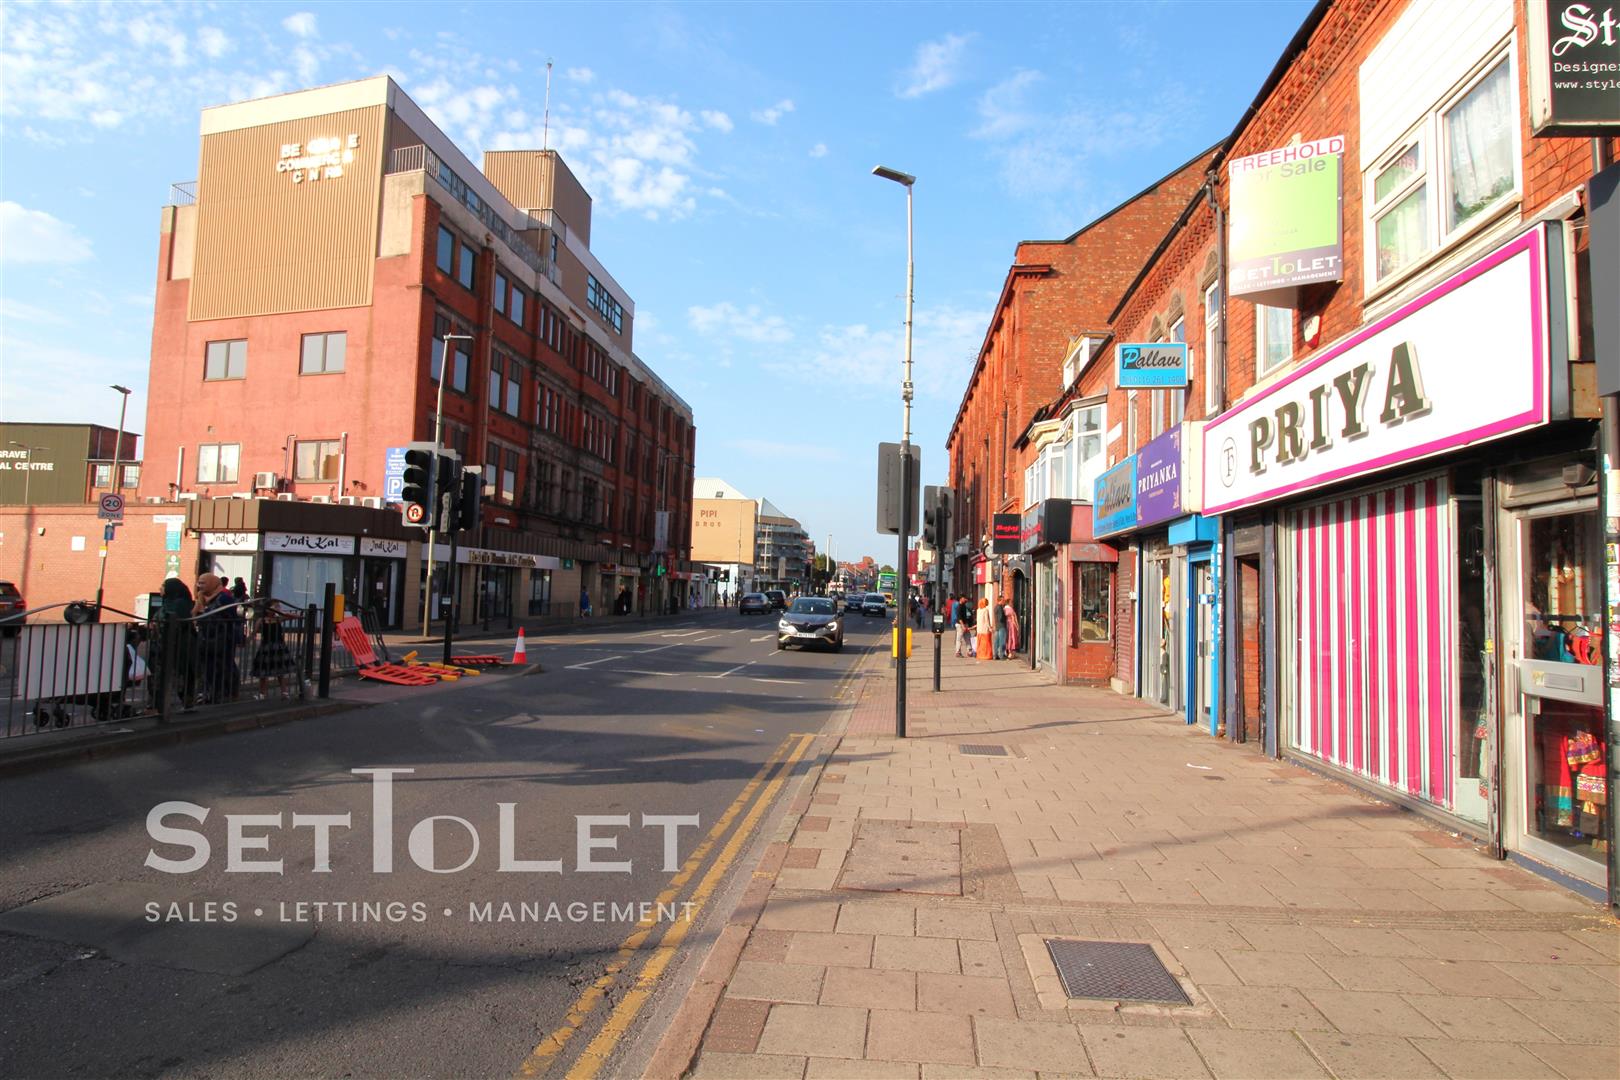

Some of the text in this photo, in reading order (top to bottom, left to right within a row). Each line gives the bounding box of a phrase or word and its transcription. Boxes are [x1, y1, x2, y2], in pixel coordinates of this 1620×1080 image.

[1552, 4, 1620, 57] St
[1231, 138, 1343, 175] FREEHOLD
[1280, 158, 1327, 179] Sale
[1248, 341, 1432, 476] PRIYA
[15, 461, 54, 471] CENTRE
[1138, 462, 1177, 494] PRIYANKA
[105, 499, 120, 508] 20
[700, 510, 718, 518] PIPI
